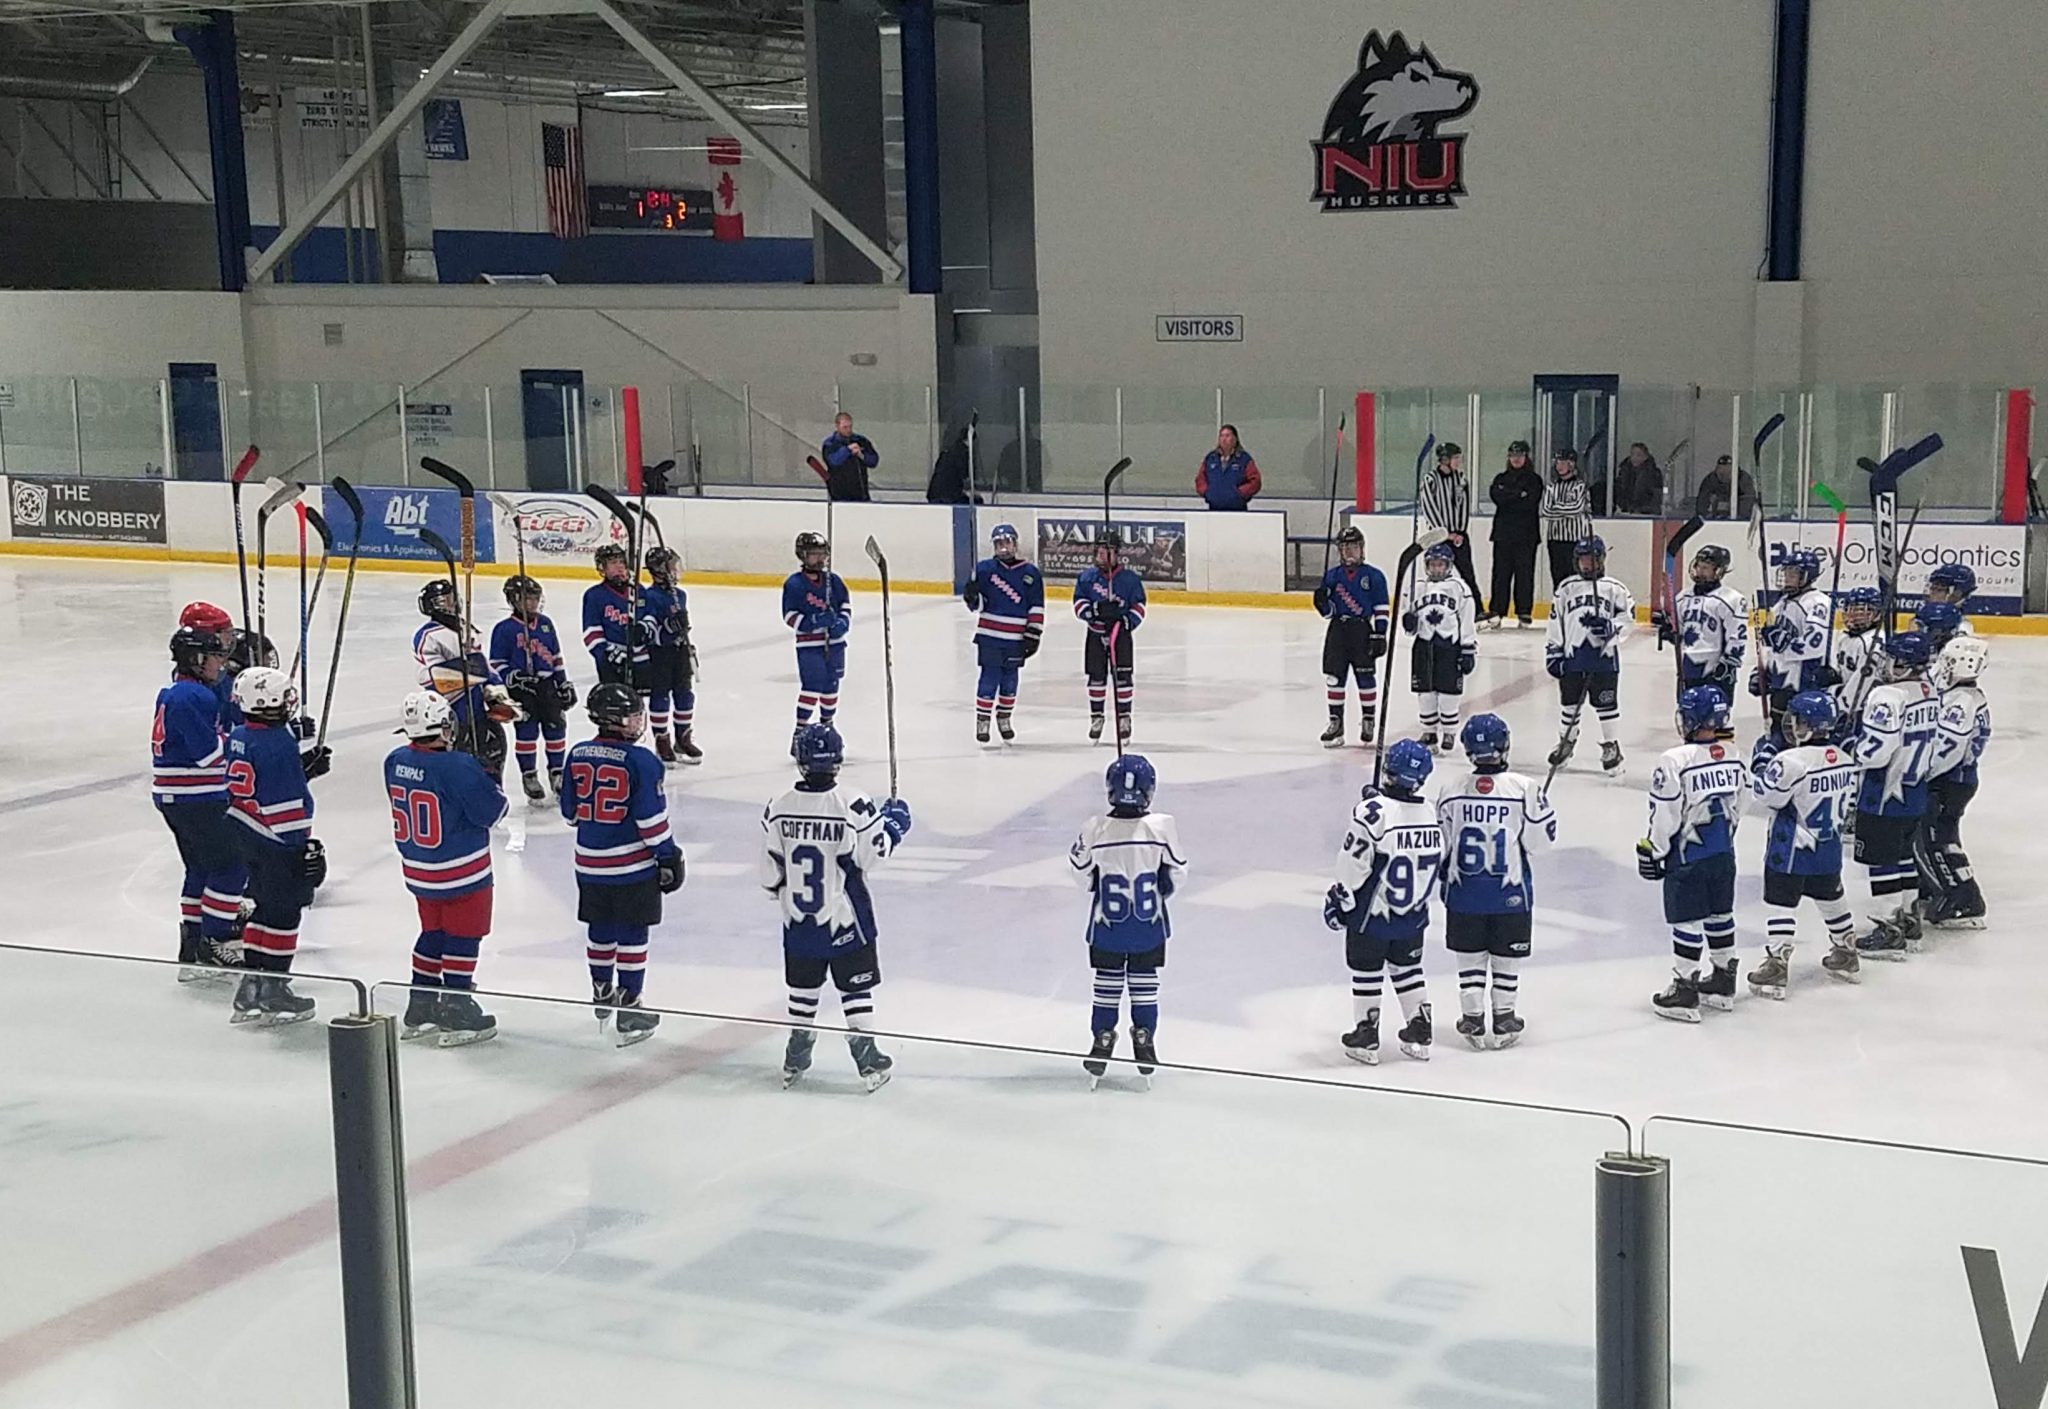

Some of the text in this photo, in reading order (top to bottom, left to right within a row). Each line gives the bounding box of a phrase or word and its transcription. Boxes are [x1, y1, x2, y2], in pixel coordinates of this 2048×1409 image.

[1322, 141, 1456, 193] NIU
[1331, 193, 1447, 207] HUSKIES
[1165, 320, 1234, 336] VISITORS
[52, 484, 91, 501] THE
[54, 510, 161, 530] KNOBBERY
[384, 495, 430, 525] Abt
[1880, 494, 1893, 568] CCM
[337, 542, 382, 554] Elecronics
[384, 543, 391, 553] &
[1414, 593, 1457, 612] LEAFS
[571, 763, 630, 824] 22
[1692, 768, 1740, 792] KNIGHT
[1463, 804, 1510, 824] HOPP
[781, 820, 844, 842] COFFMAN
[1344, 831, 1370, 860] 97
[1457, 827, 1509, 875] 61
[791, 845, 825, 914] 3
[1385, 852, 1442, 909] 97
[1934, 851, 1958, 887] CCM
[1101, 872, 1159, 921] 66
